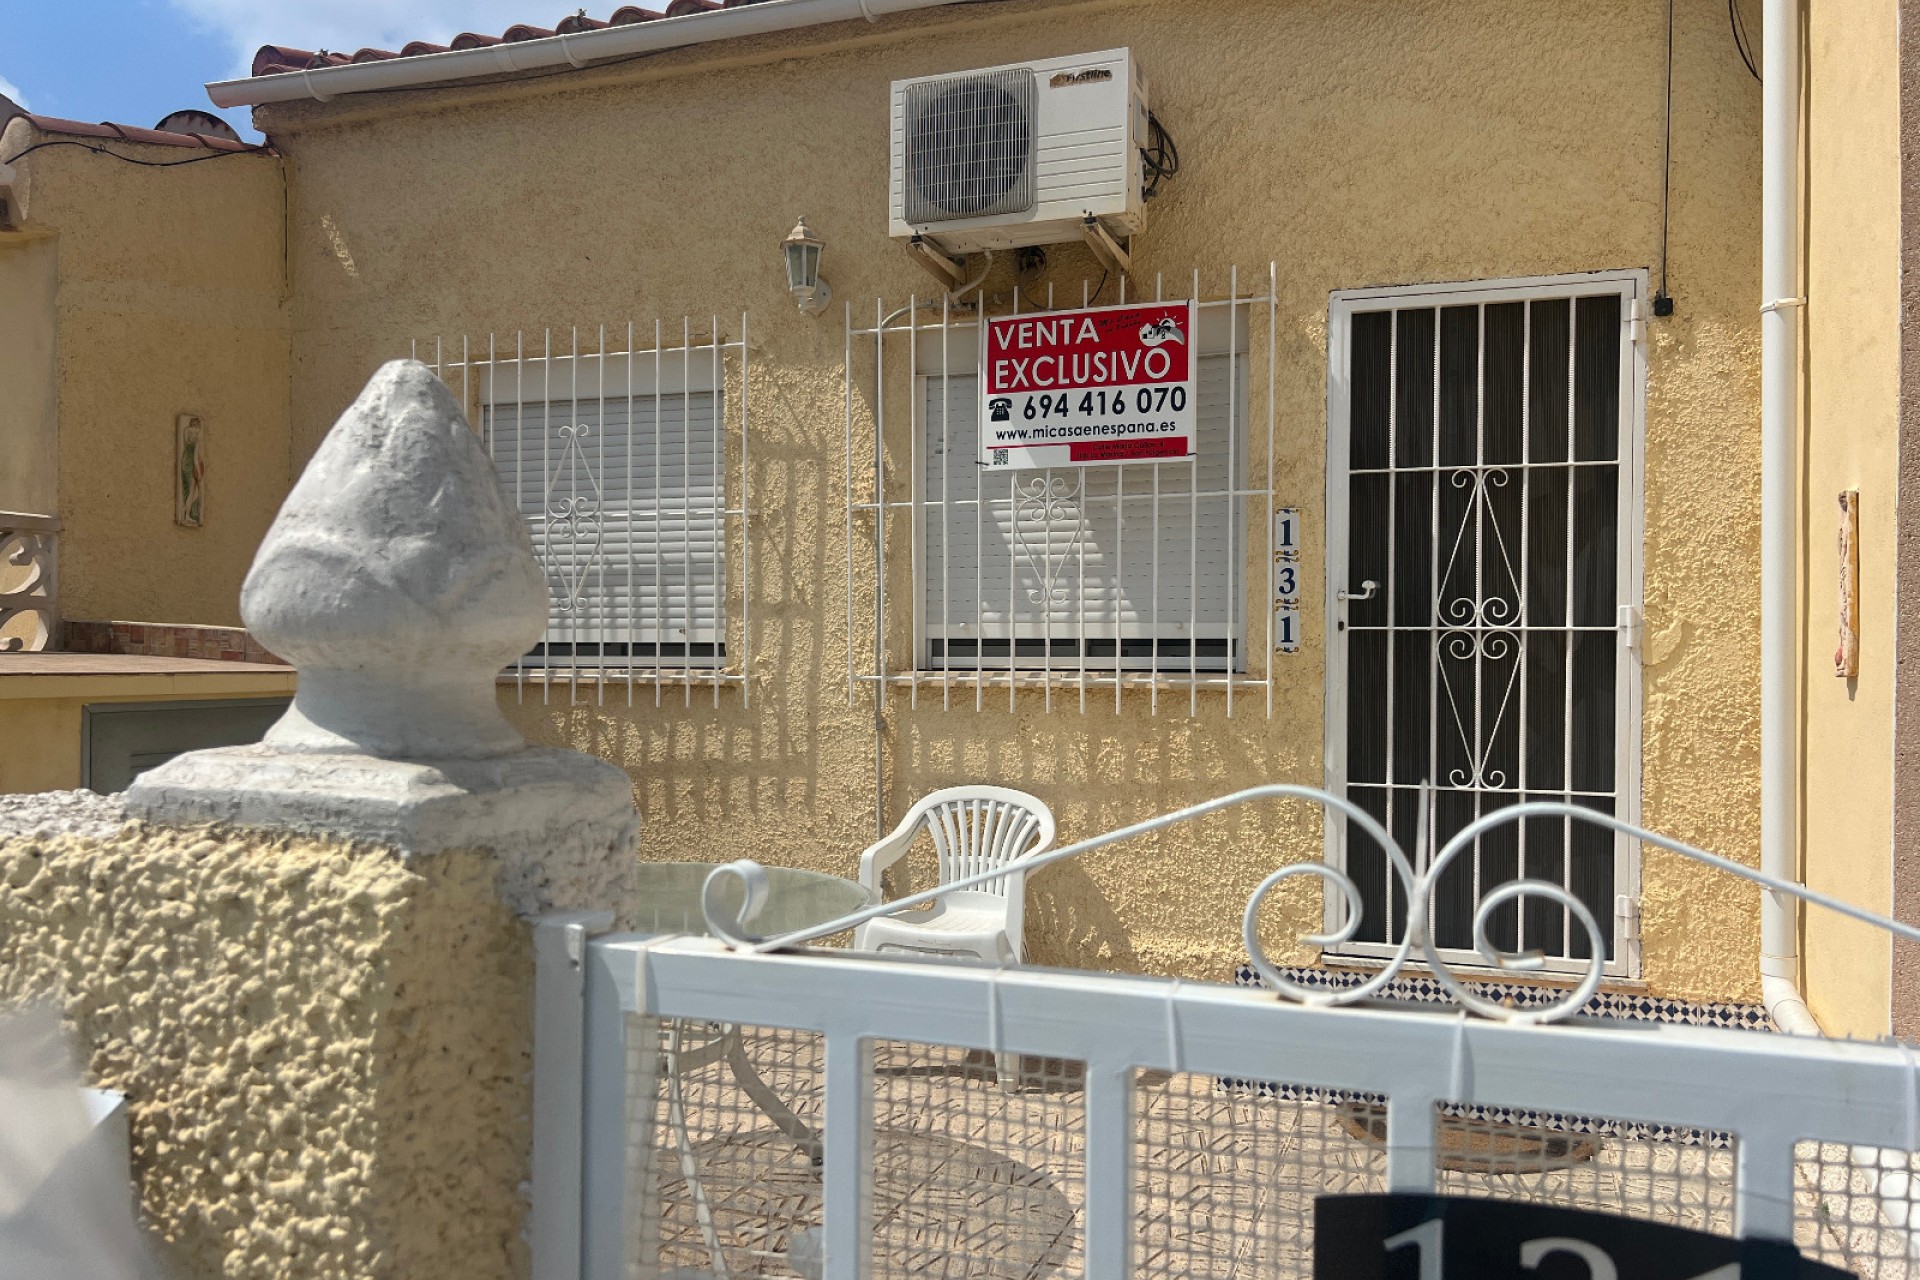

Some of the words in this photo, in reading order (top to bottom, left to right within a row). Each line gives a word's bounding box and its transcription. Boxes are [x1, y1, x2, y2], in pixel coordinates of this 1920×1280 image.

[994, 317, 1100, 350] VENTA
[995, 347, 1171, 389] EXCLUSIVO
[1023, 393, 1069, 420] 694
[1078, 390, 1126, 416] 416
[1136, 386, 1187, 414] 070
[995, 420, 1176, 441] www.micasaenespana.es
